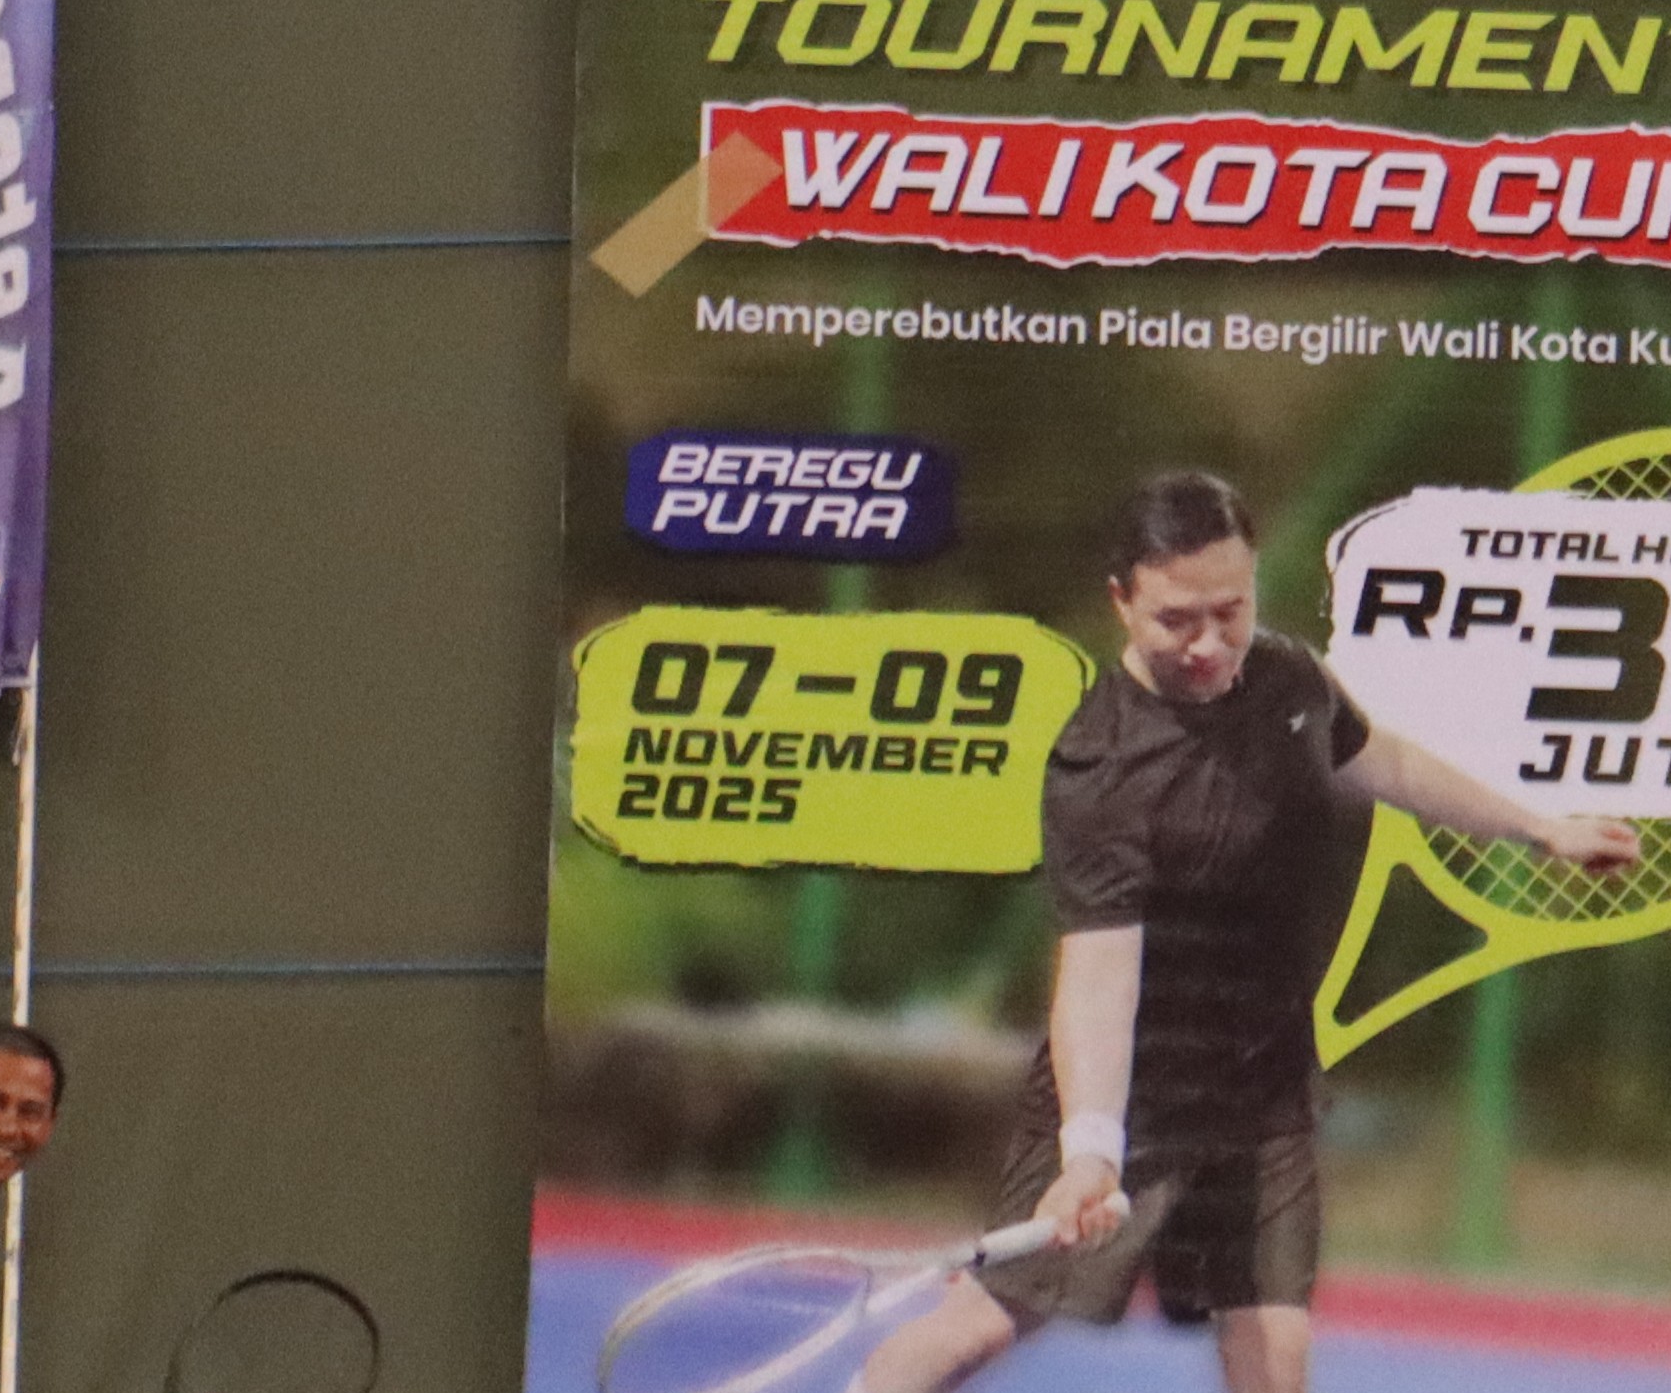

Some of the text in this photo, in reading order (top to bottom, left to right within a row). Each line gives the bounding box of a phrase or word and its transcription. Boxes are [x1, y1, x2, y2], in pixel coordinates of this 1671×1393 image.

[783, 129, 1079, 215] WALI
[1093, 139, 1446, 231] KOTA
[695, 295, 1086, 347] Memperebutkan
[1099, 308, 1212, 351] Piala
[1223, 312, 1388, 365] Bergilir
[1398, 319, 1500, 360] Wali
[1510, 324, 1618, 364] Kota
[658, 444, 923, 492] BEREGU
[652, 487, 911, 541] PUTRA
[1460, 527, 1620, 562] TOTAL
[1351, 567, 1536, 643] RP.
[623, 725, 1011, 780] NOVEMBER
[615, 773, 803, 826] 2025
